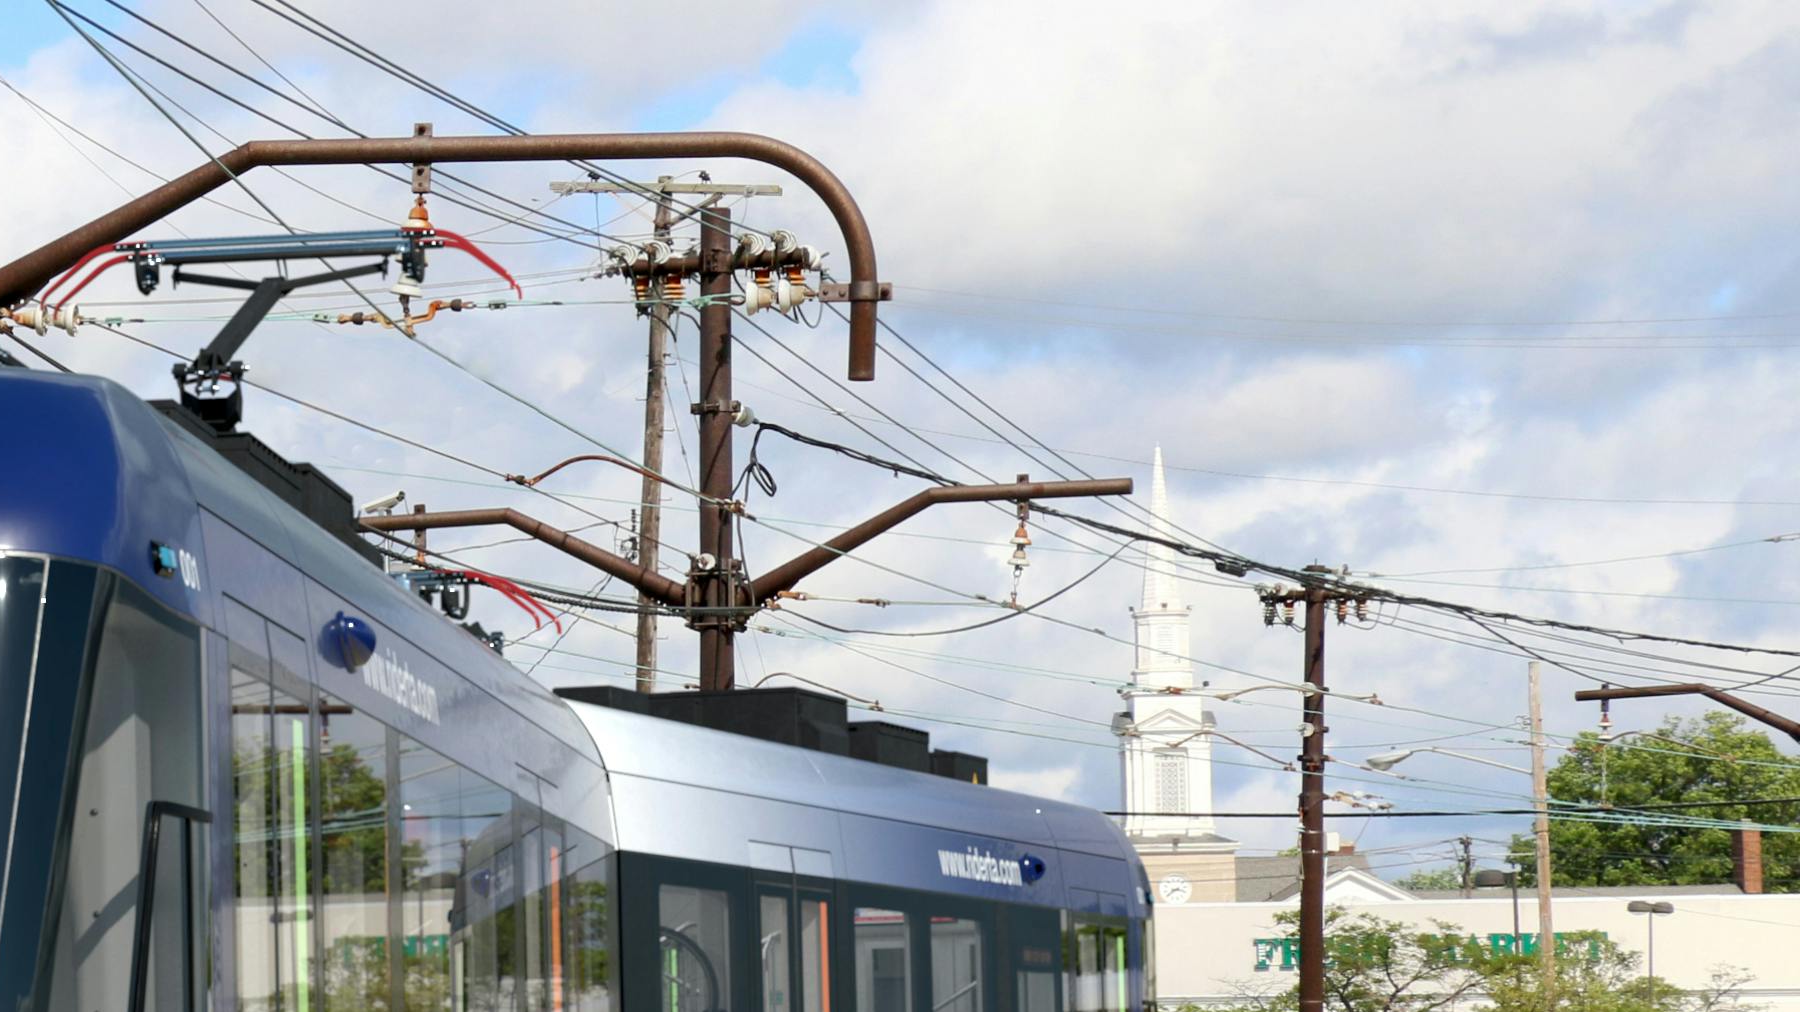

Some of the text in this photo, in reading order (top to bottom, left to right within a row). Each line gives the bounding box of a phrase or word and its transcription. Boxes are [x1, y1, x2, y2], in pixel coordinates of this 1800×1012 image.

[178, 548, 201, 592] 001
[937, 846, 1023, 887] www.riderta.com
[1417, 931, 1609, 964] ARKT
